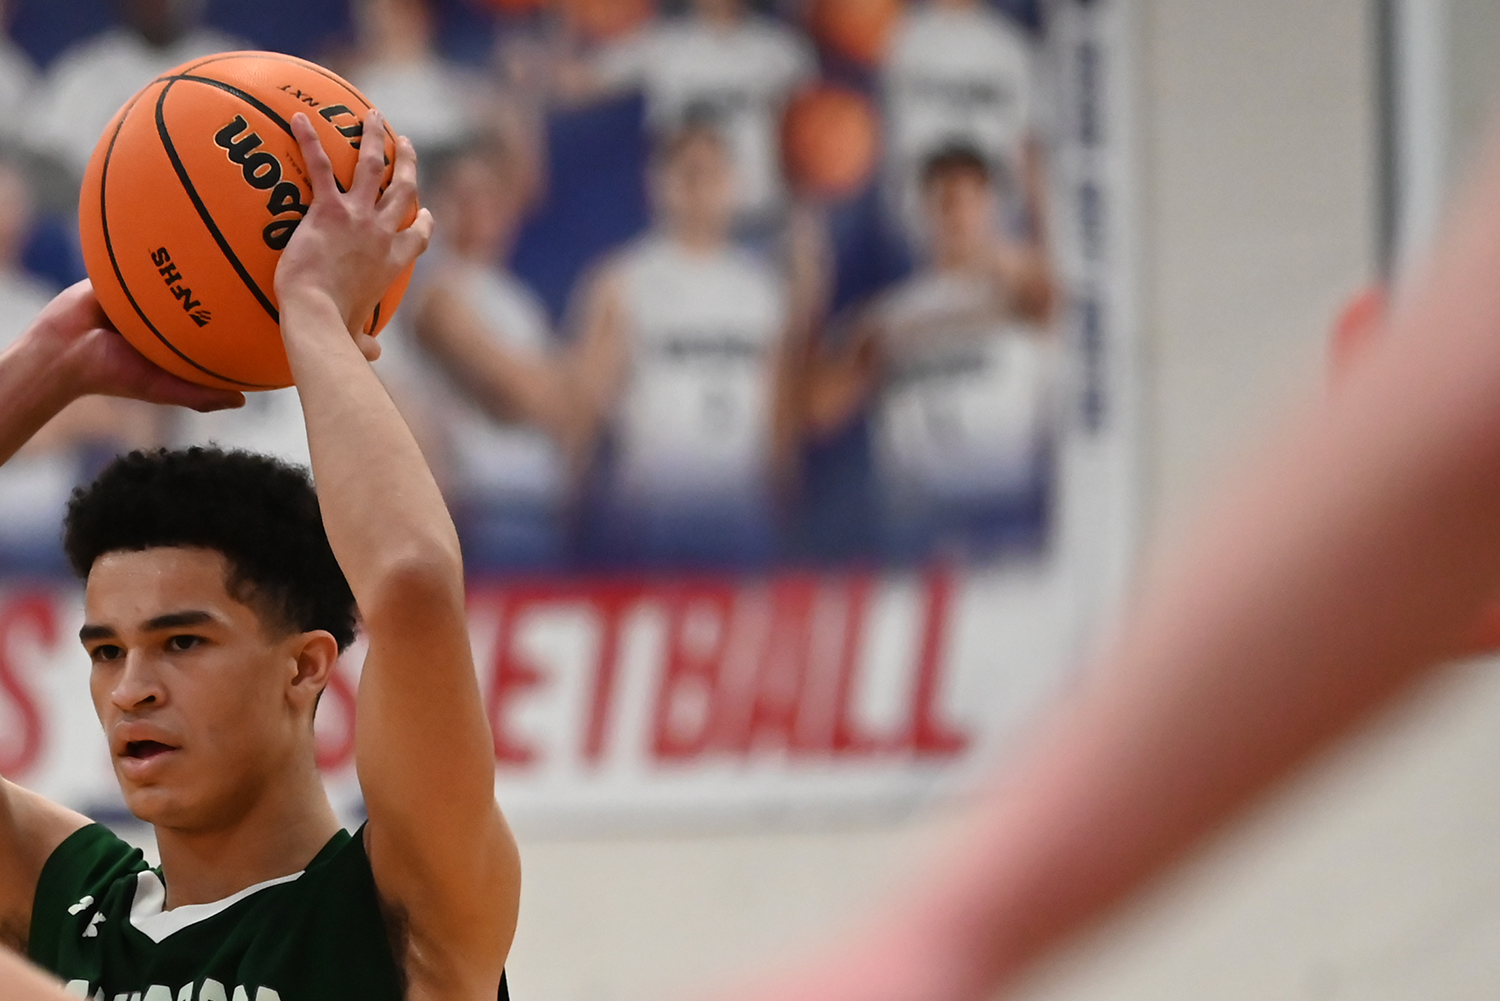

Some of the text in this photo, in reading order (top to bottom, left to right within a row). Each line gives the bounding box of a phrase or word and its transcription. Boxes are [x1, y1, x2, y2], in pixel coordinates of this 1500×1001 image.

[278, 85, 319, 108] NXT
[213, 113, 309, 251] lson
[150, 247, 201, 312] NFHS
[315, 575, 968, 772] ETBALL
